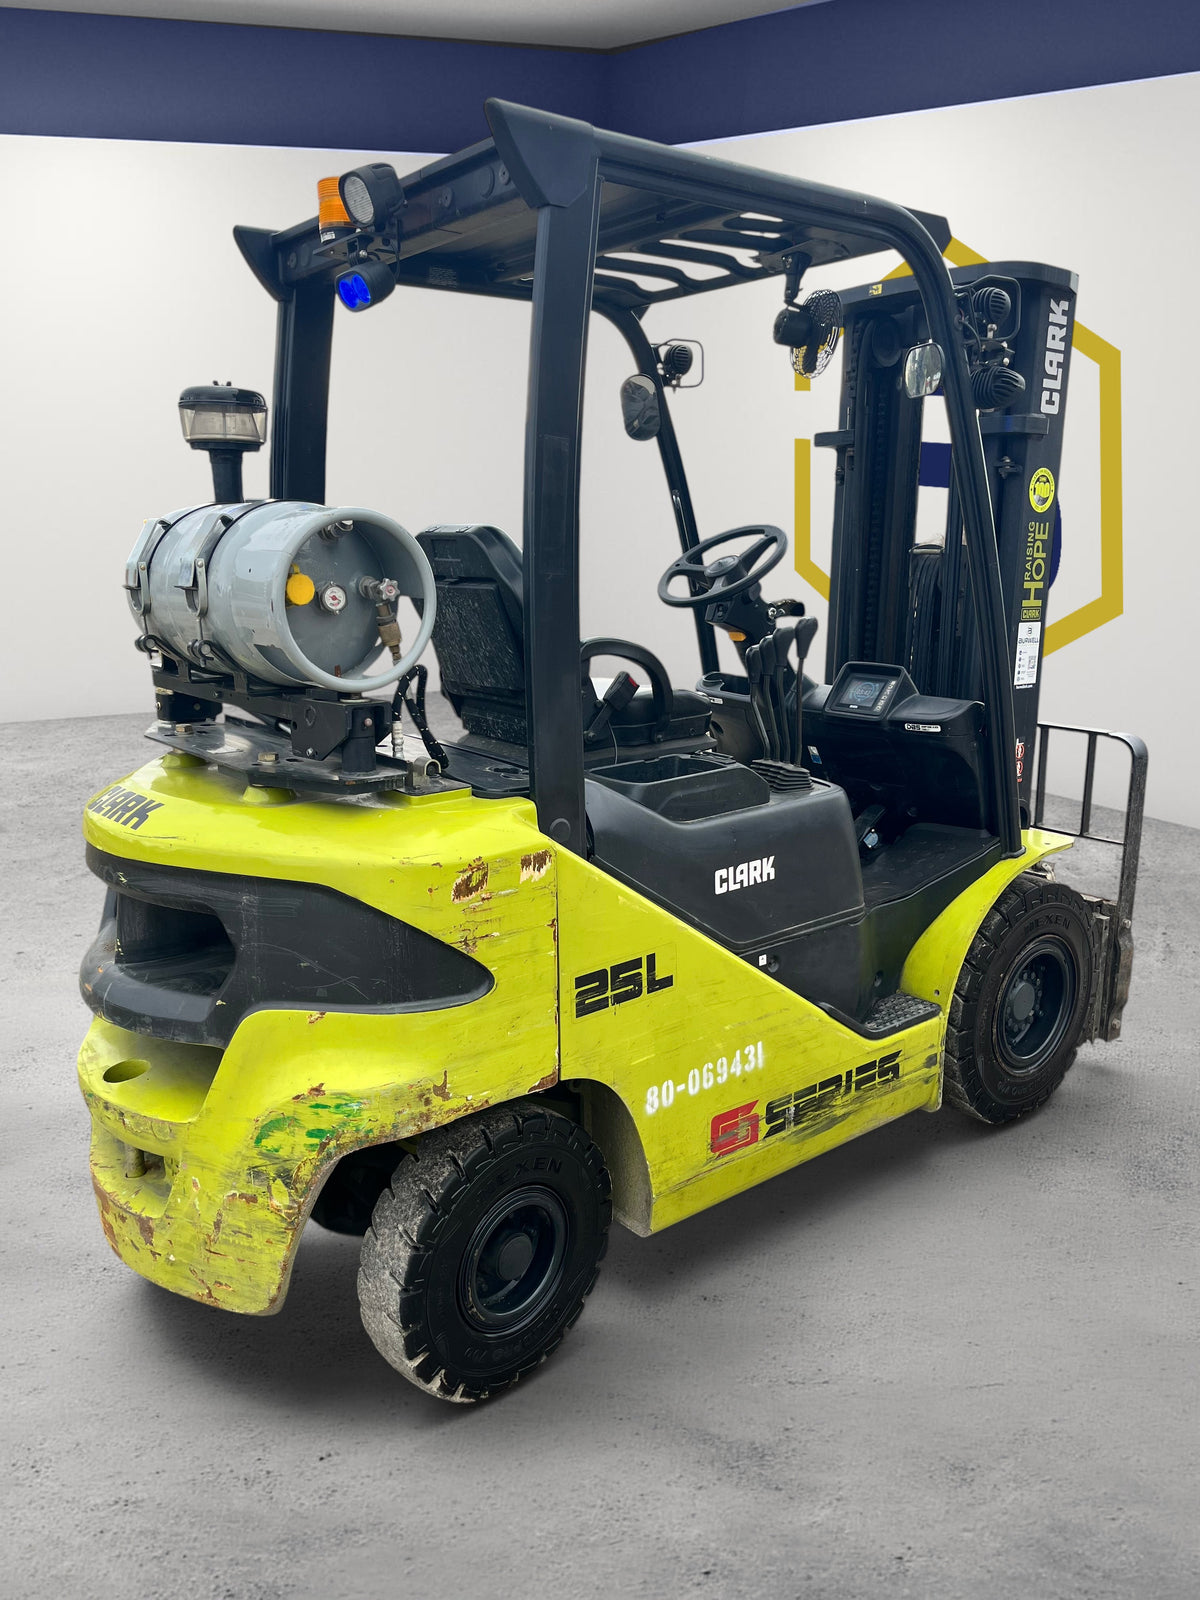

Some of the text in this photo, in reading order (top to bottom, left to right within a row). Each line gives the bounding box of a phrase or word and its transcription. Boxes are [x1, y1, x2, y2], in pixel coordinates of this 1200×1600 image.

[1040, 299, 1069, 415] CLARK
[1021, 522, 1050, 607] HOPE
[1024, 521, 1036, 581] RAISING
[1022, 609, 1040, 619] CLARK
[87, 785, 165, 831] CLARK
[714, 855, 776, 895] CLARK
[574, 952, 674, 1019] 25L
[645, 1041, 766, 1115] 80-069431
